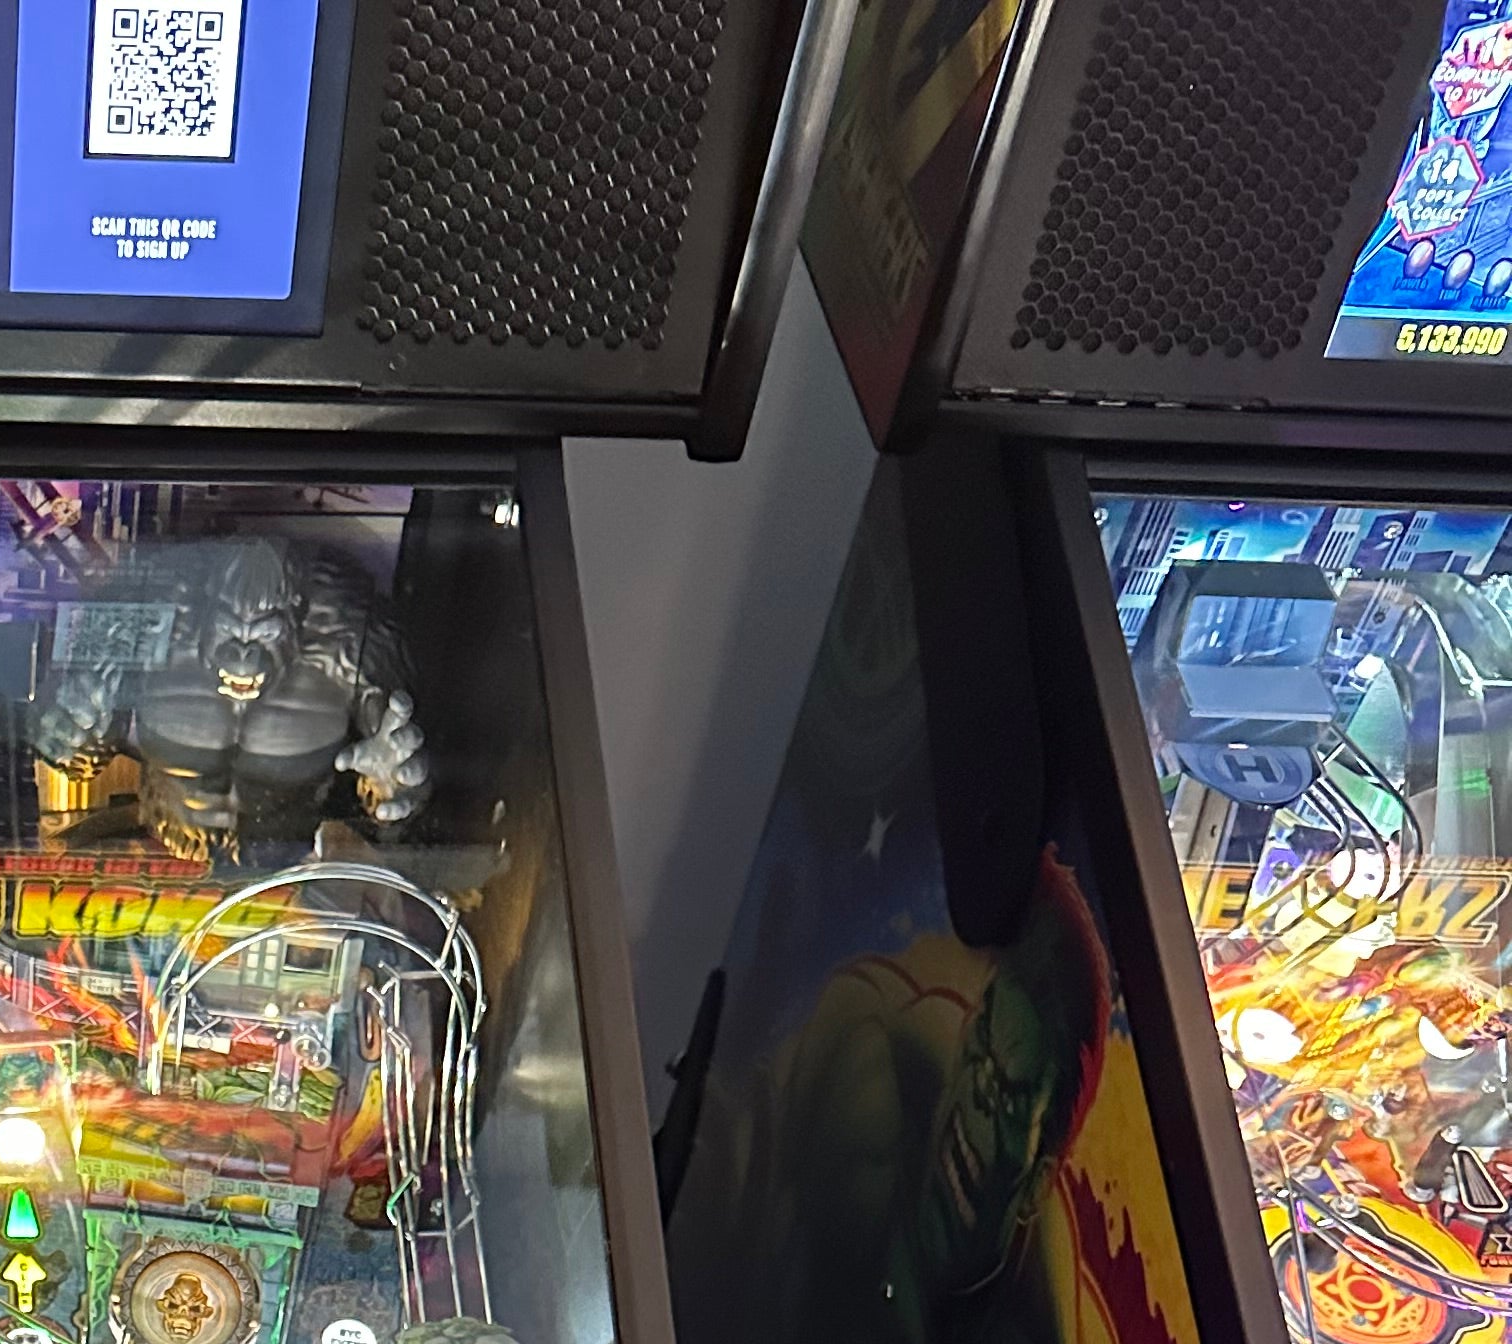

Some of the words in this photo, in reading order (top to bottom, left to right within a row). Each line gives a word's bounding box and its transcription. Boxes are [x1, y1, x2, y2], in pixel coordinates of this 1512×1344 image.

[1430, 159, 1460, 185] 14
[92, 217, 126, 235] SCAN
[129, 218, 159, 237] THIS
[162, 219, 180, 240] QR
[183, 220, 216, 239] CODE
[117, 239, 134, 258] TO
[136, 240, 168, 258] SIGN
[171, 241, 190, 259] UP
[1396, 323, 1508, 356] 5,133,990
